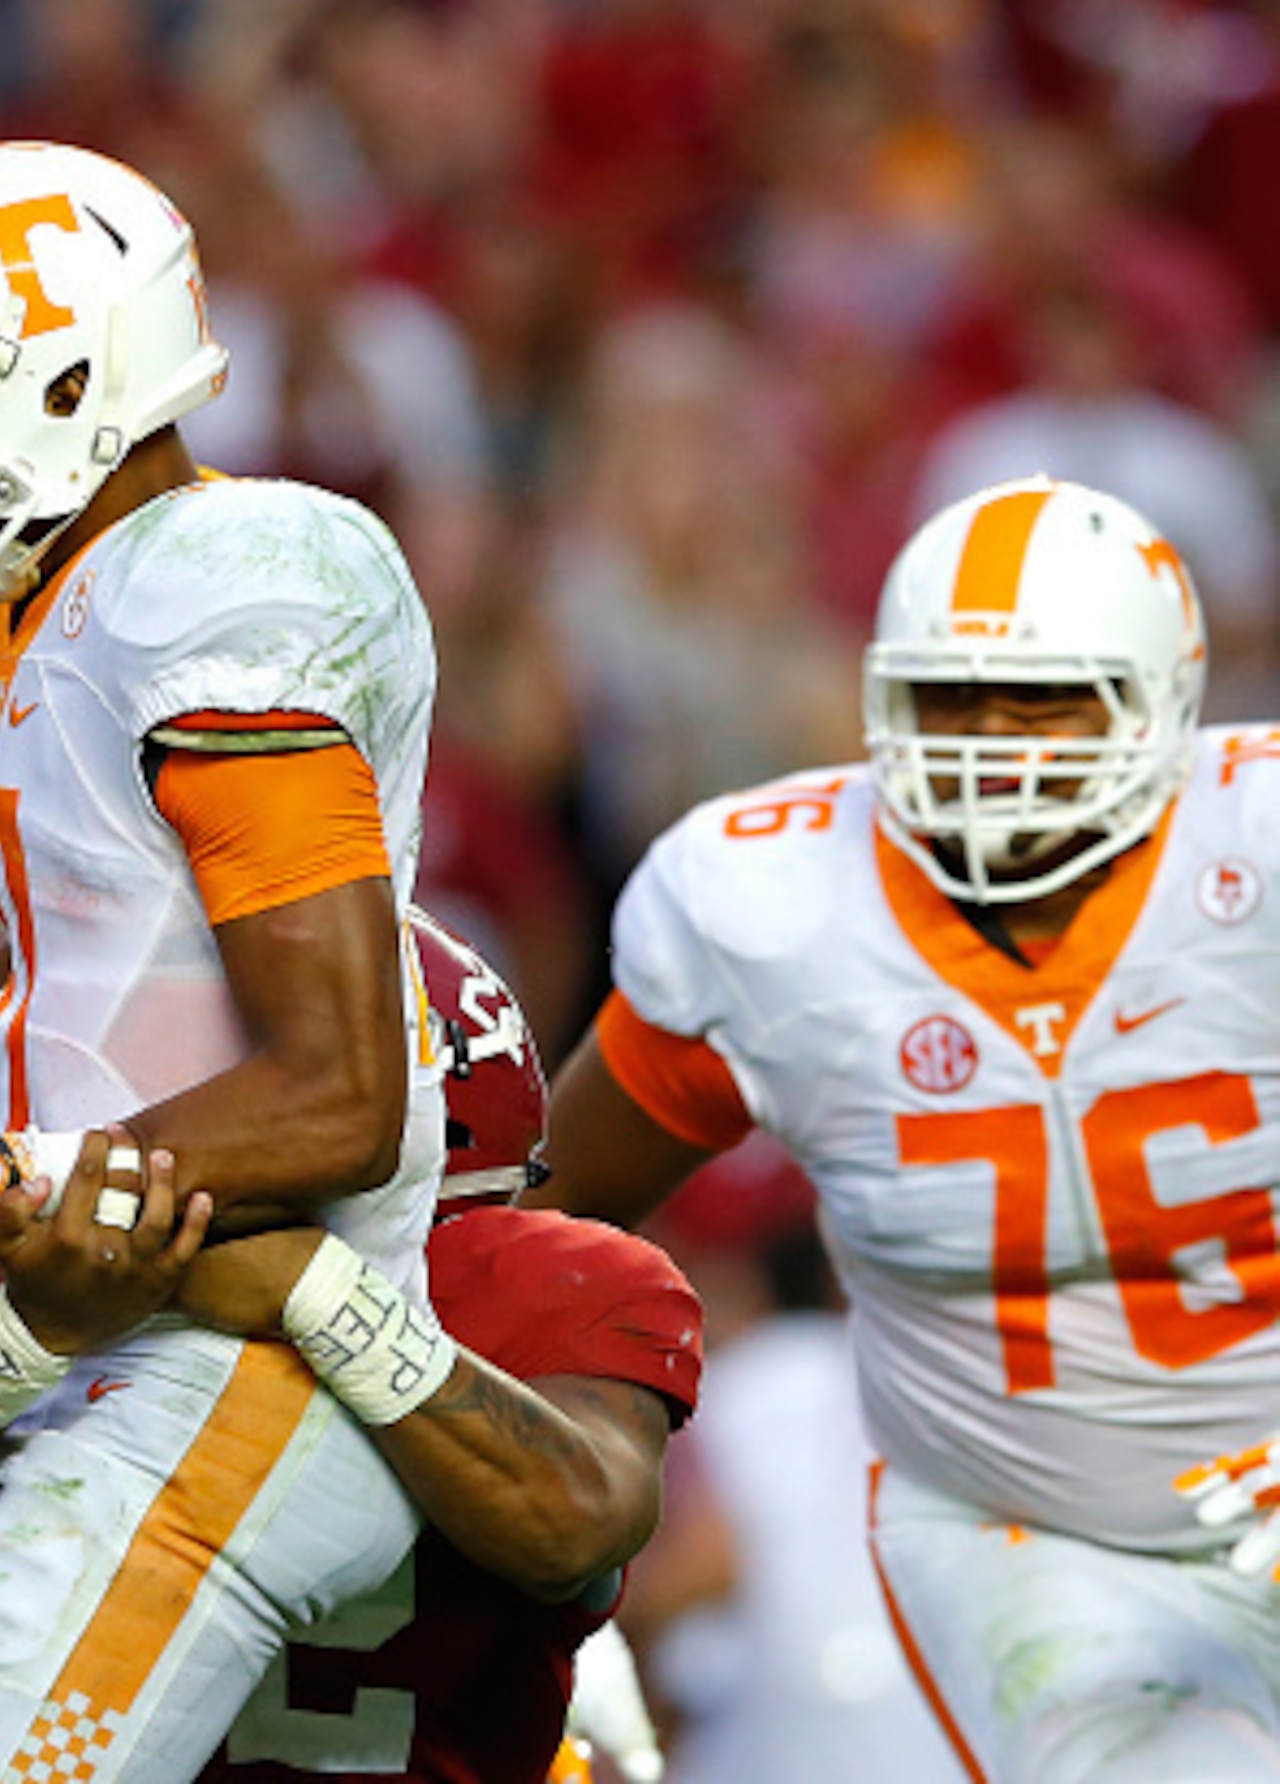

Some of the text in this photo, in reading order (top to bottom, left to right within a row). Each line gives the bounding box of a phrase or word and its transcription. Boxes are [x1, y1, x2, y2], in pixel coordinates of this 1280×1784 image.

[903, 1017, 977, 1091] SEC
[1015, 1002, 1066, 1056] T
[895, 1069, 1280, 1396] 76
